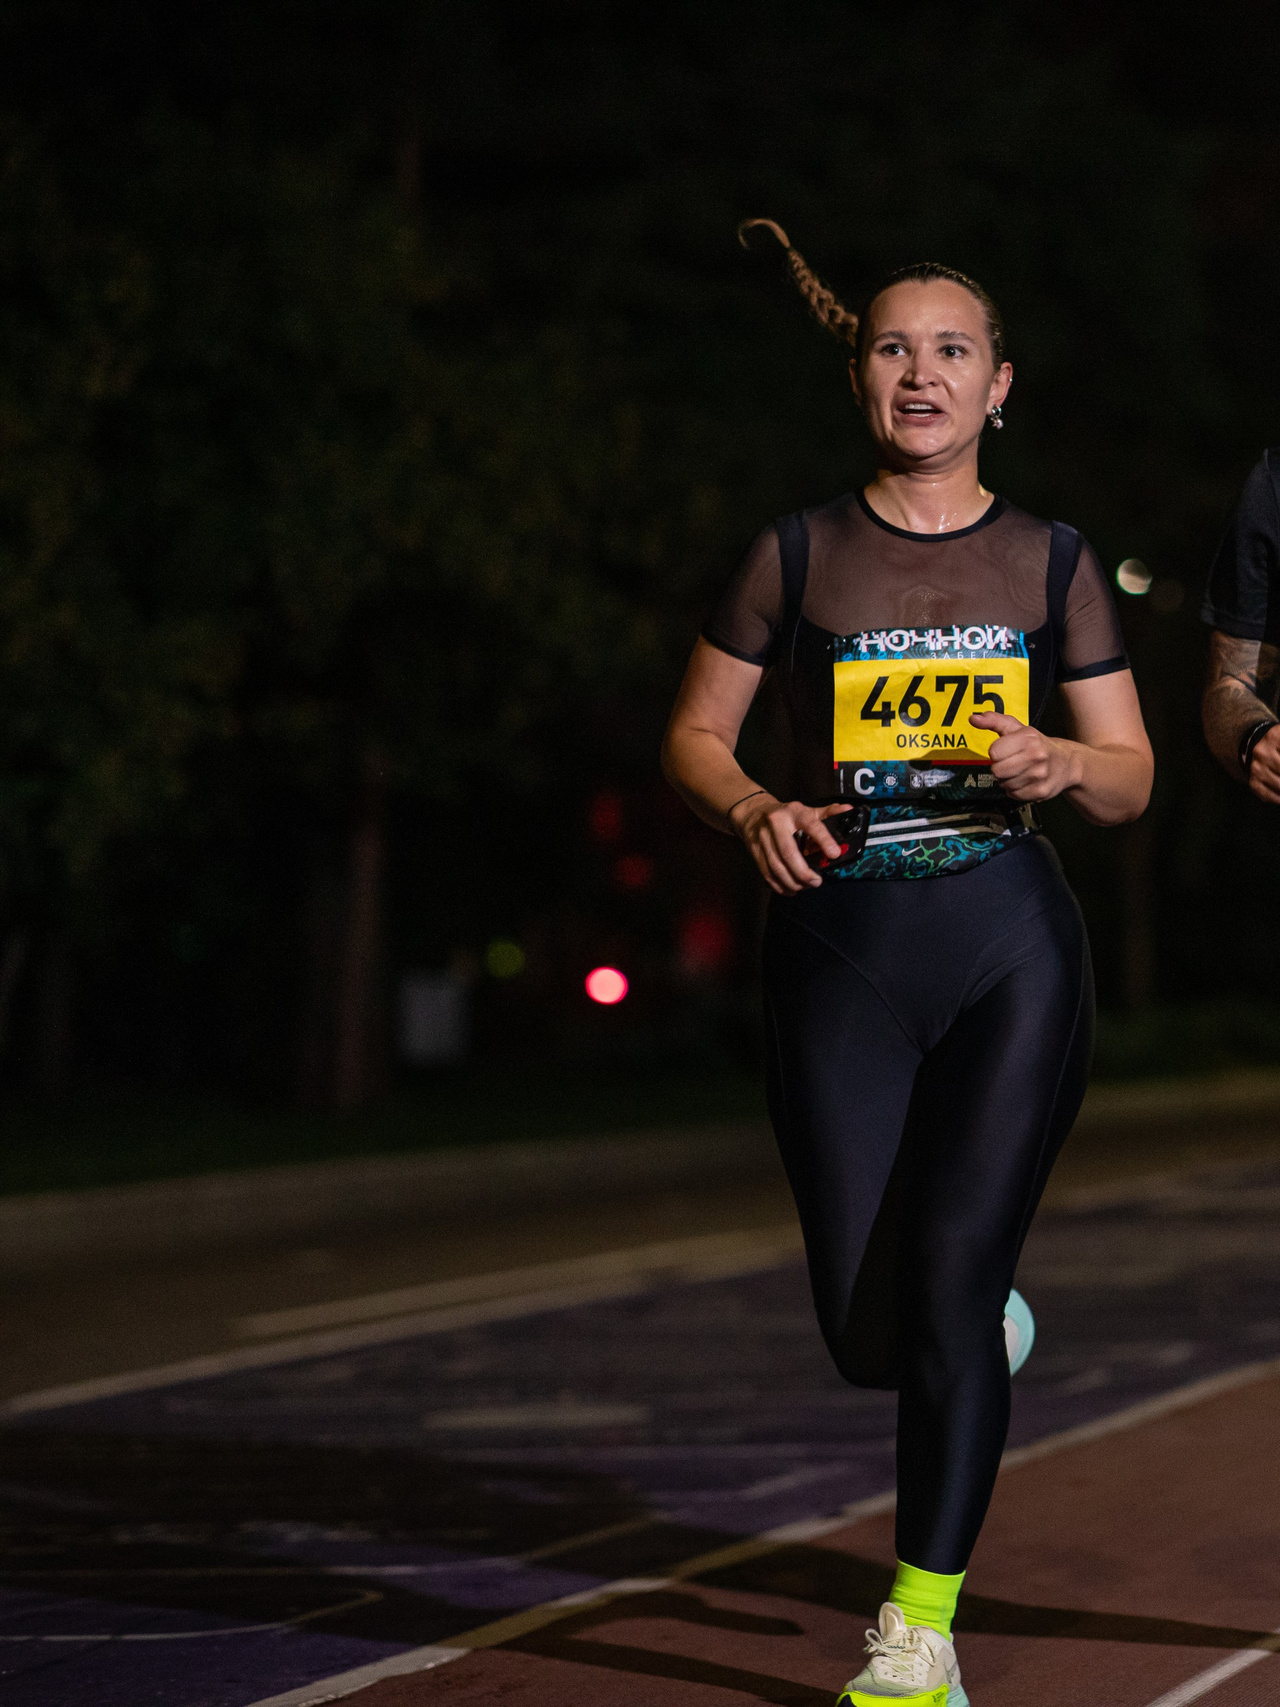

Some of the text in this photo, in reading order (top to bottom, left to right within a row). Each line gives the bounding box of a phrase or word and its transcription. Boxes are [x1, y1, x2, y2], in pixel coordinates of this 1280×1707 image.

[853, 624, 1012, 653] НОЧНОЙ
[860, 675, 1005, 728] 4675
[896, 734, 968, 749] OKSANA
[854, 768, 875, 795] C
